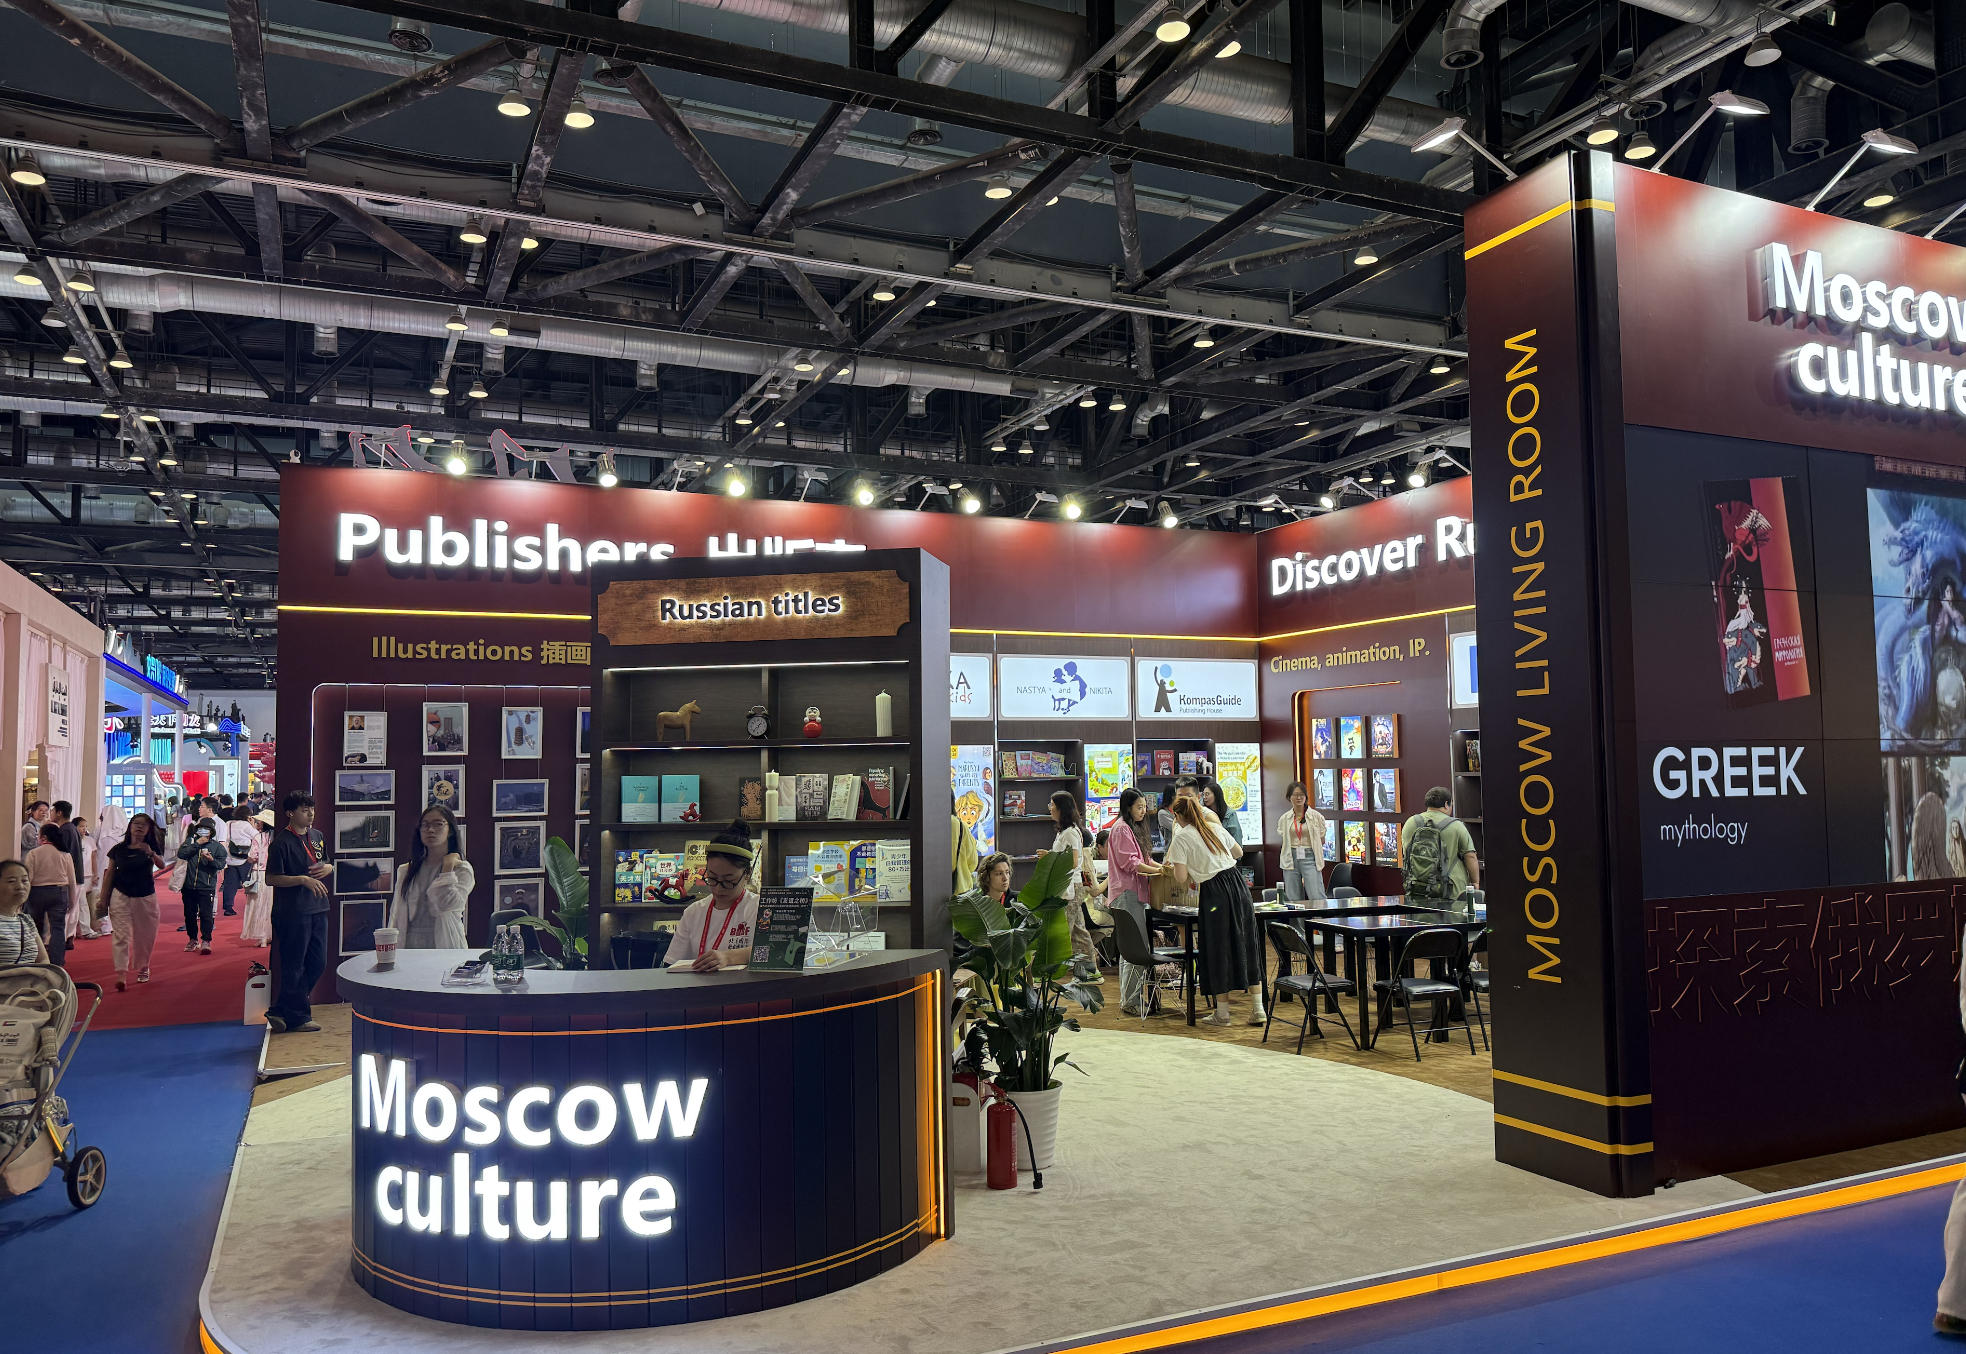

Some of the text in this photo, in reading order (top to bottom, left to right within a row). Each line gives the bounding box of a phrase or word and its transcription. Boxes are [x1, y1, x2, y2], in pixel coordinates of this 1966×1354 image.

[1270, 533, 1424, 597] Discover
[659, 591, 842, 622] Russian titles
[371, 637, 591, 666] Illustrations 插画
[1270, 638, 1431, 674] Cinema, animation, IP.
[1504, 328, 1562, 984] MOSCOW LIVING ROOM
[1016, 686, 1113, 695] NASTYA and NIKITA
[1179, 694, 1242, 709] KompasGuide
[1179, 707, 1206, 715] Publishing
[1652, 745, 1808, 800] GREEK
[1660, 813, 1749, 848] mythology
[359, 1053, 710, 1147] Moscow
[376, 1152, 678, 1241] culture
